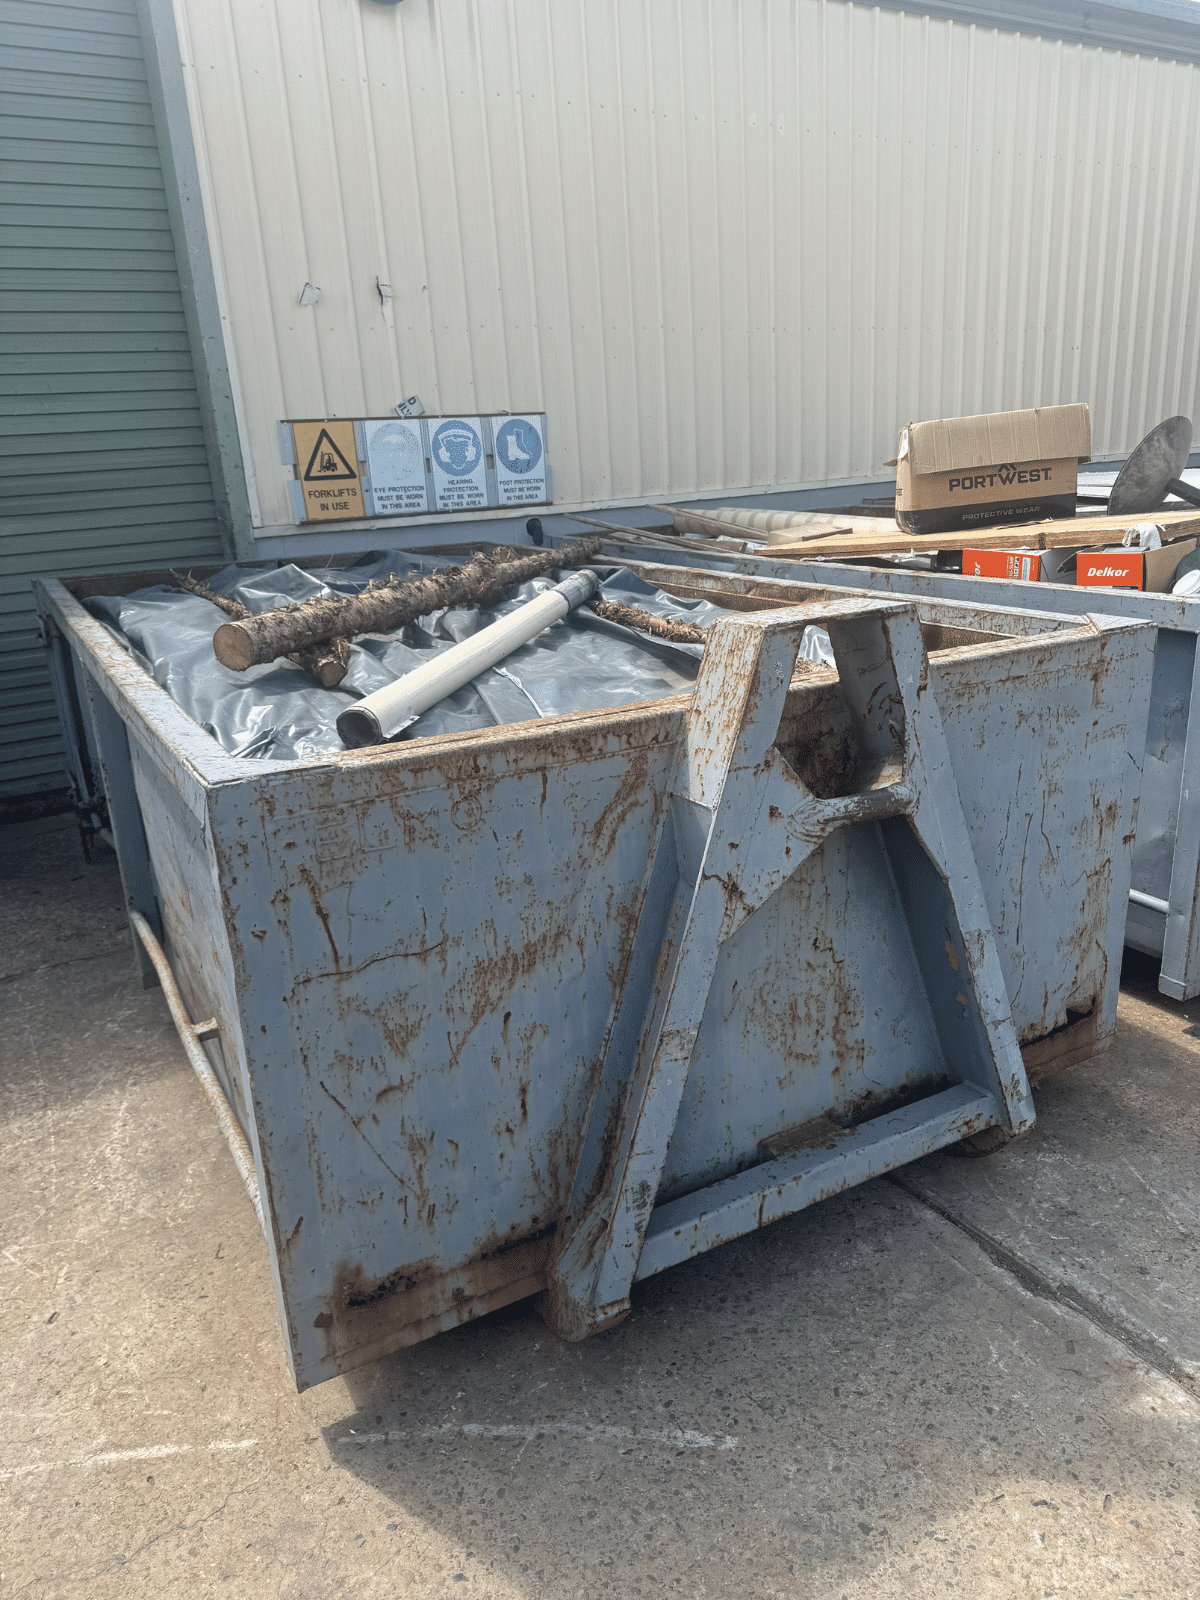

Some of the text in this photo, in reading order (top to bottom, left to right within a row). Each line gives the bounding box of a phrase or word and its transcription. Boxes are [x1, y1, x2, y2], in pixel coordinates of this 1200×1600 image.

[513, 477, 545, 485] PROTECTION
[388, 485, 425, 493] PROTECTION
[308, 488, 357, 499] FORKLIFTS
[439, 493, 455, 501] MUST
[377, 494, 394, 502] MUST
[320, 501, 350, 511] IN USE
[404, 501, 421, 509] AREA
[962, 506, 1041, 521] PROTECTIVE WEAR
[1087, 566, 1130, 577] Delkor
